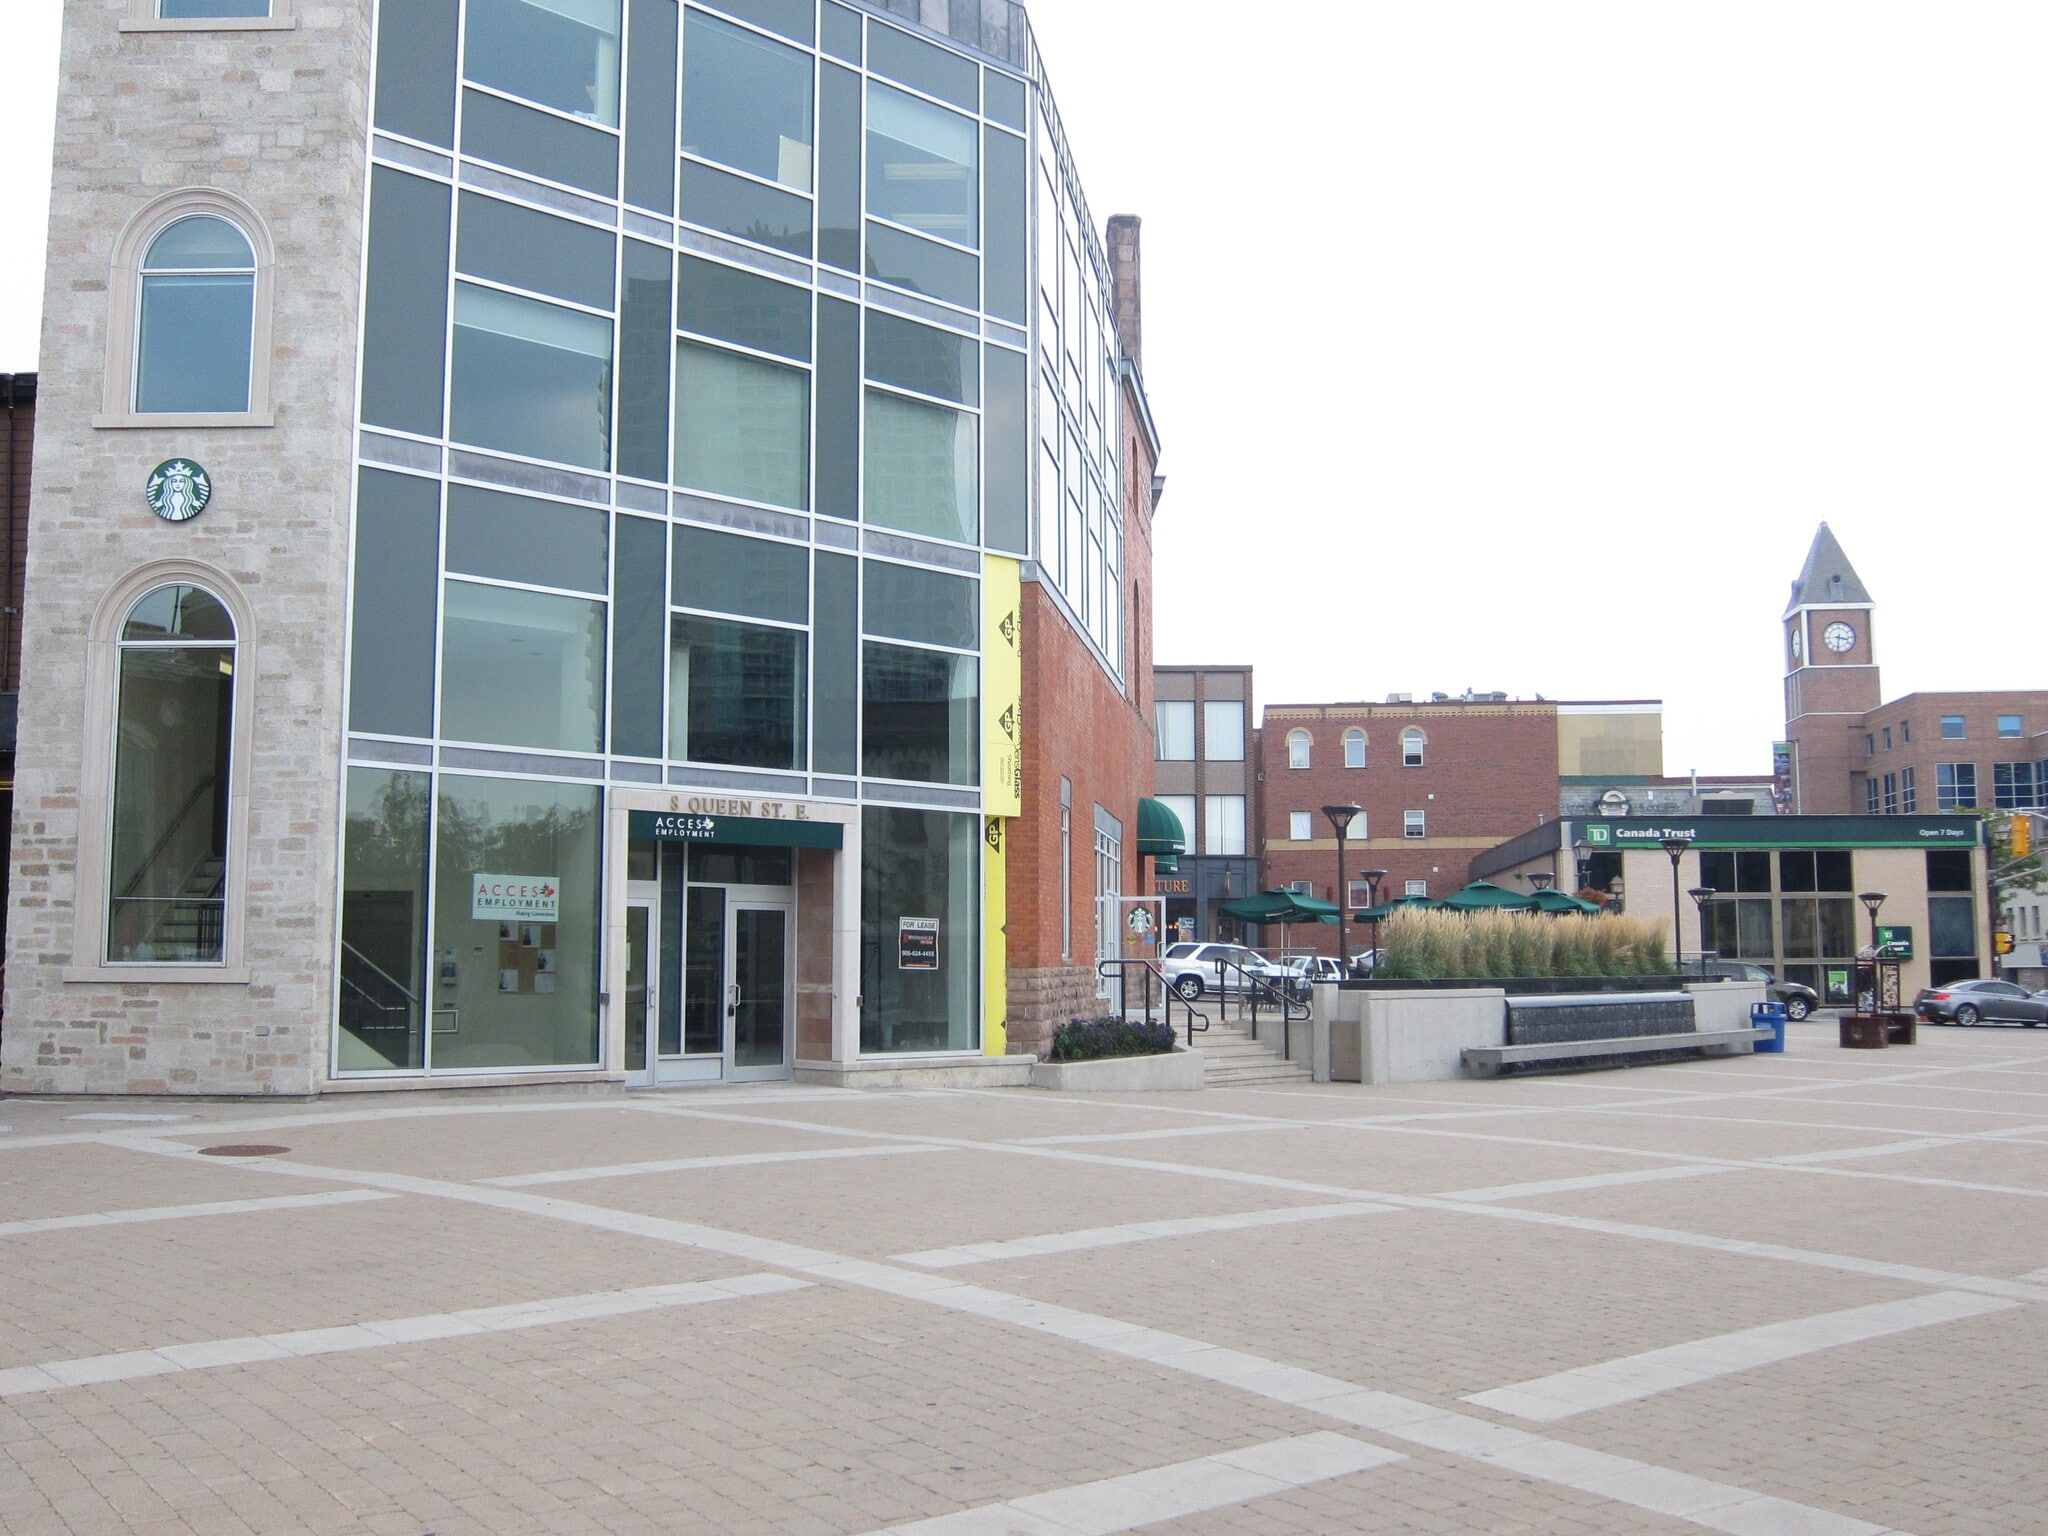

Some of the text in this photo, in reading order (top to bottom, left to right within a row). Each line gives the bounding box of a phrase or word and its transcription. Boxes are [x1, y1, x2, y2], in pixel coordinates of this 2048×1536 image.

[1004, 618, 1012, 639] GP
[1004, 712, 1012, 733] GP
[670, 795, 810, 820] 8 QUEEN ST. E.
[655, 817, 703, 830] ACCES
[655, 828, 715, 838] EMPLOYMENT
[989, 824, 998, 845] GP
[1590, 828, 1696, 841] TD Canada Trust
[1919, 829, 1939, 837] Open
[1946, 829, 1964, 837] Days
[478, 884, 539, 898] ACCES
[477, 897, 556, 908] EMPLOYMENT
[917, 921, 936, 929] LEASE
